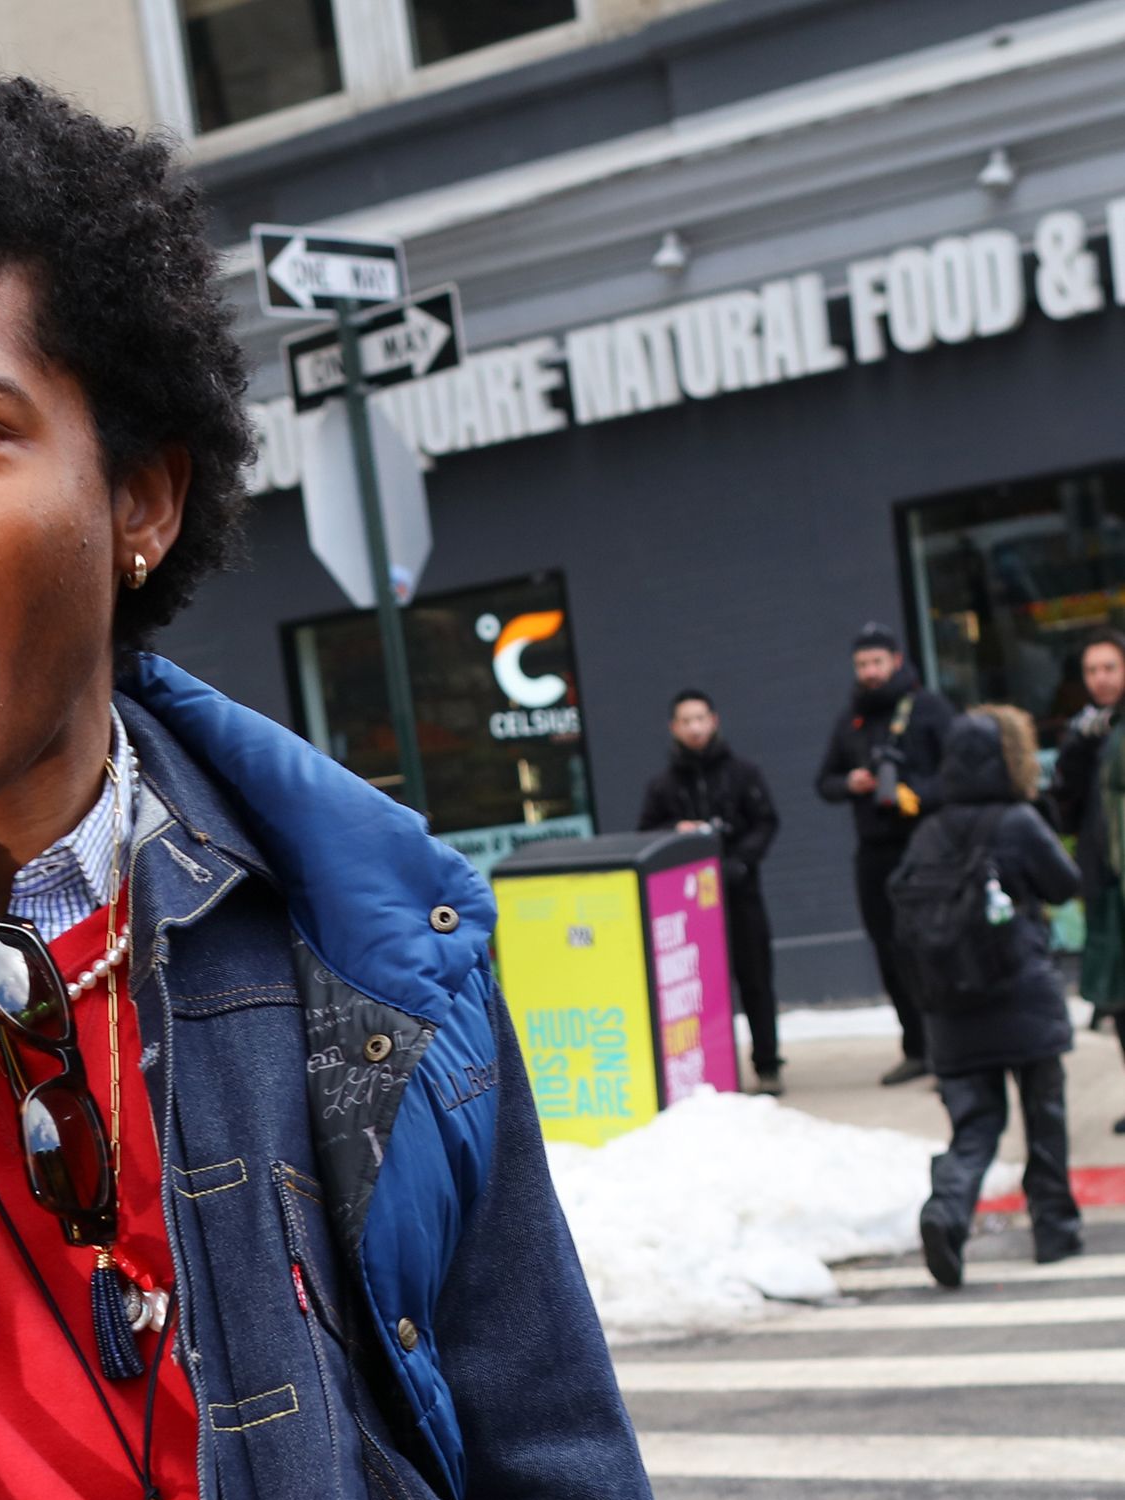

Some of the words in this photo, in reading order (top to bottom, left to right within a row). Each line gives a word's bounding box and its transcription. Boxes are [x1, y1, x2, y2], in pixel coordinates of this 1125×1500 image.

[289, 257, 329, 289] ONE
[348, 263, 388, 290] WAY
[368, 334, 569, 475] UARE
[565, 272, 847, 426] NATURAL
[847, 230, 1024, 365] FOOD
[1035, 209, 1105, 320] &
[383, 325, 430, 358] WAY
[489, 707, 581, 739] CELSIUS
